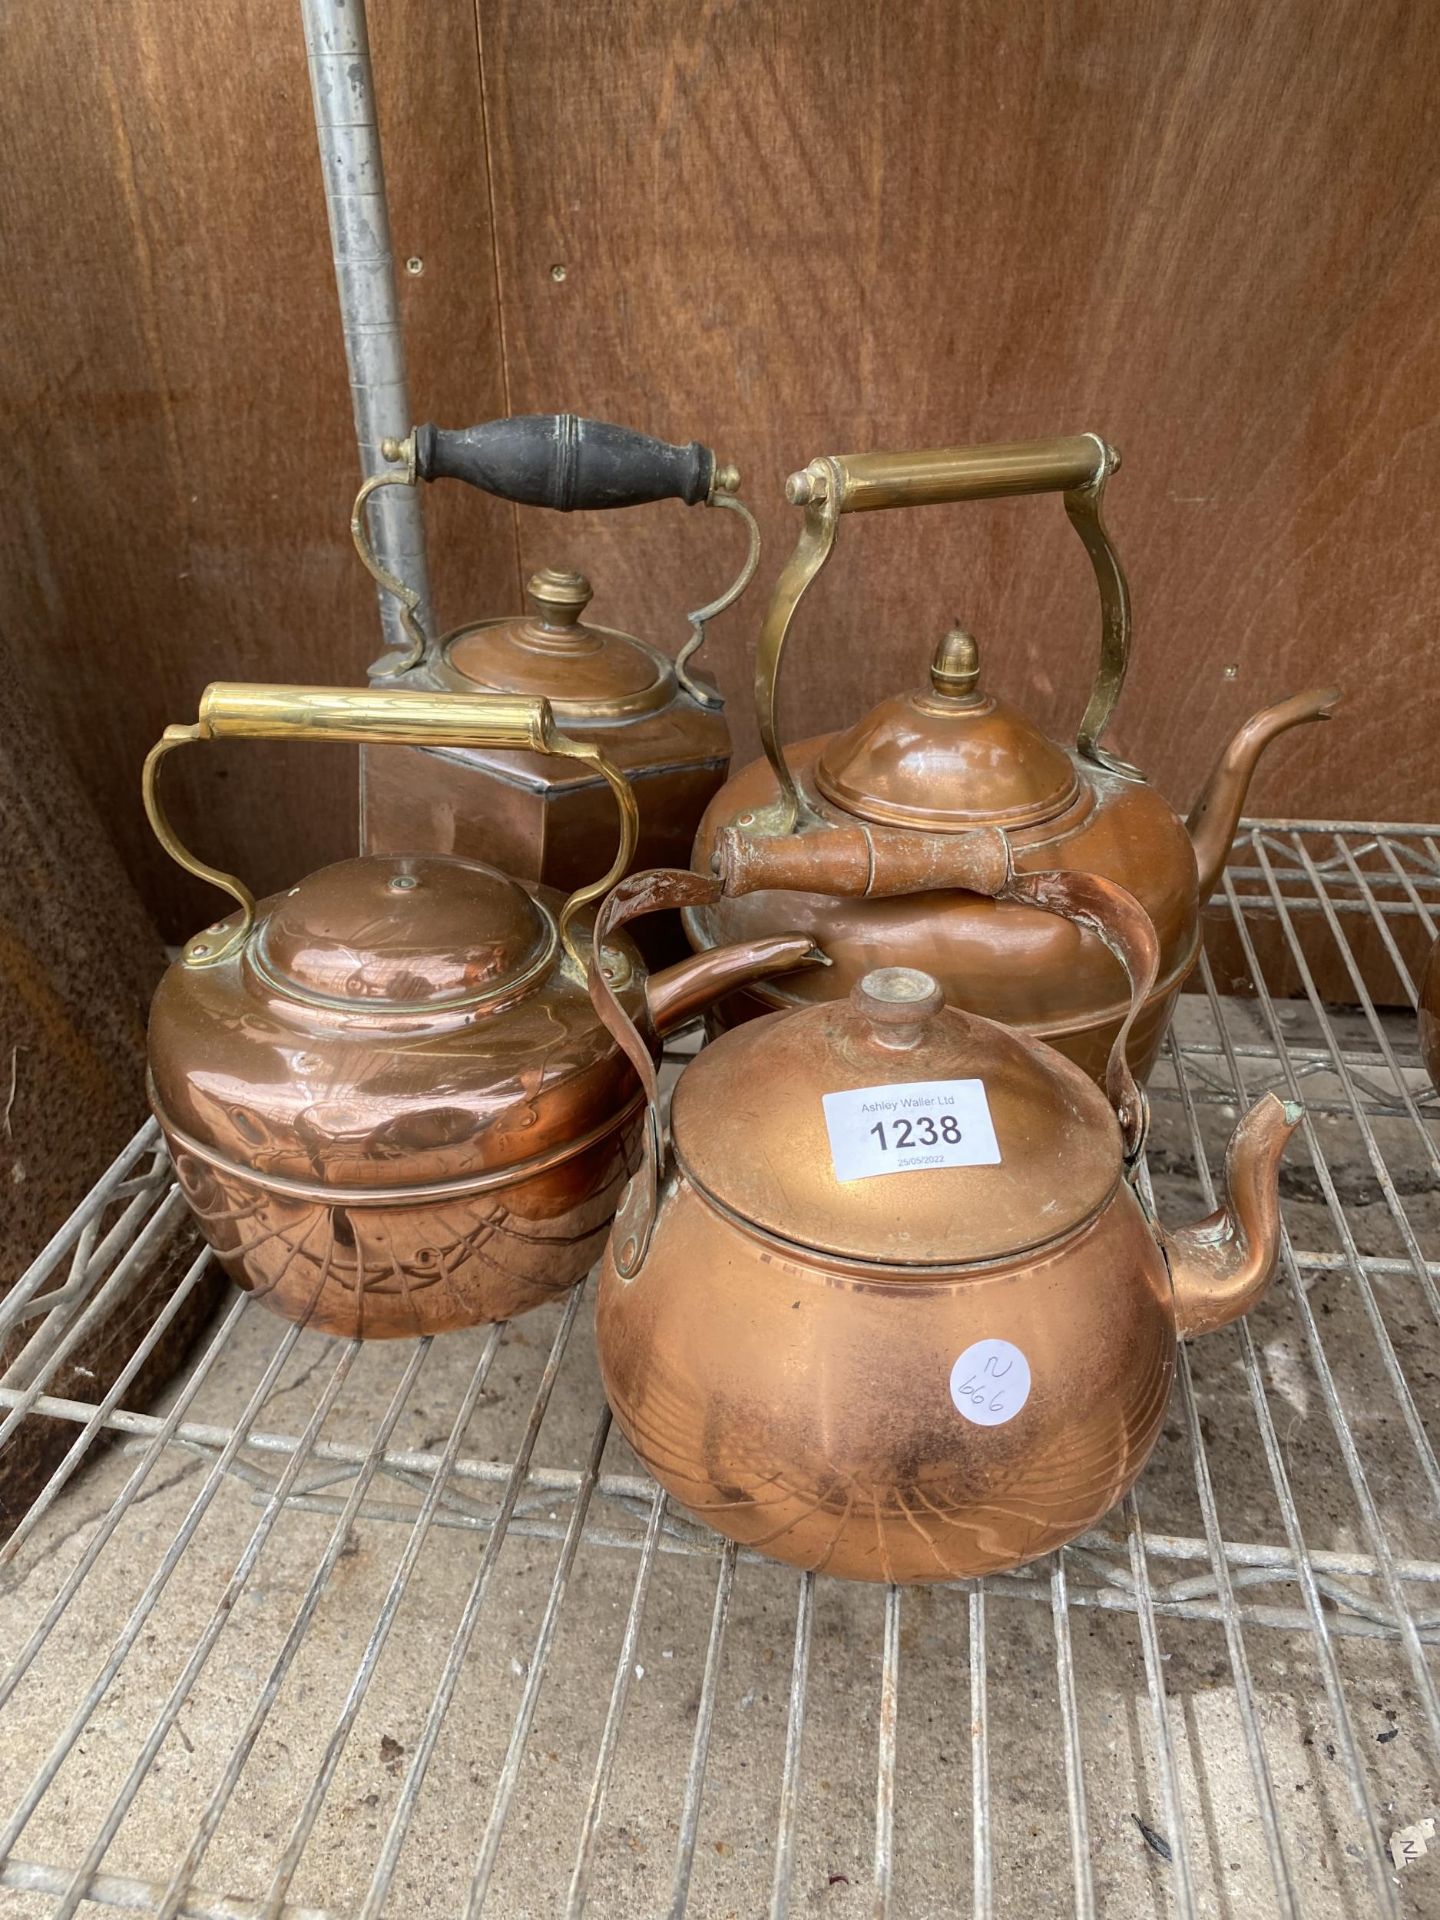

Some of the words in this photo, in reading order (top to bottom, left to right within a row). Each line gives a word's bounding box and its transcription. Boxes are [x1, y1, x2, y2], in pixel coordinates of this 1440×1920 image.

[862, 1101, 898, 1113] Ashley
[900, 1098, 935, 1108] Waller
[937, 1096, 955, 1105] Ltd
[870, 1115, 962, 1151] 1238
[898, 1155, 945, 1167] 25/05/2022
